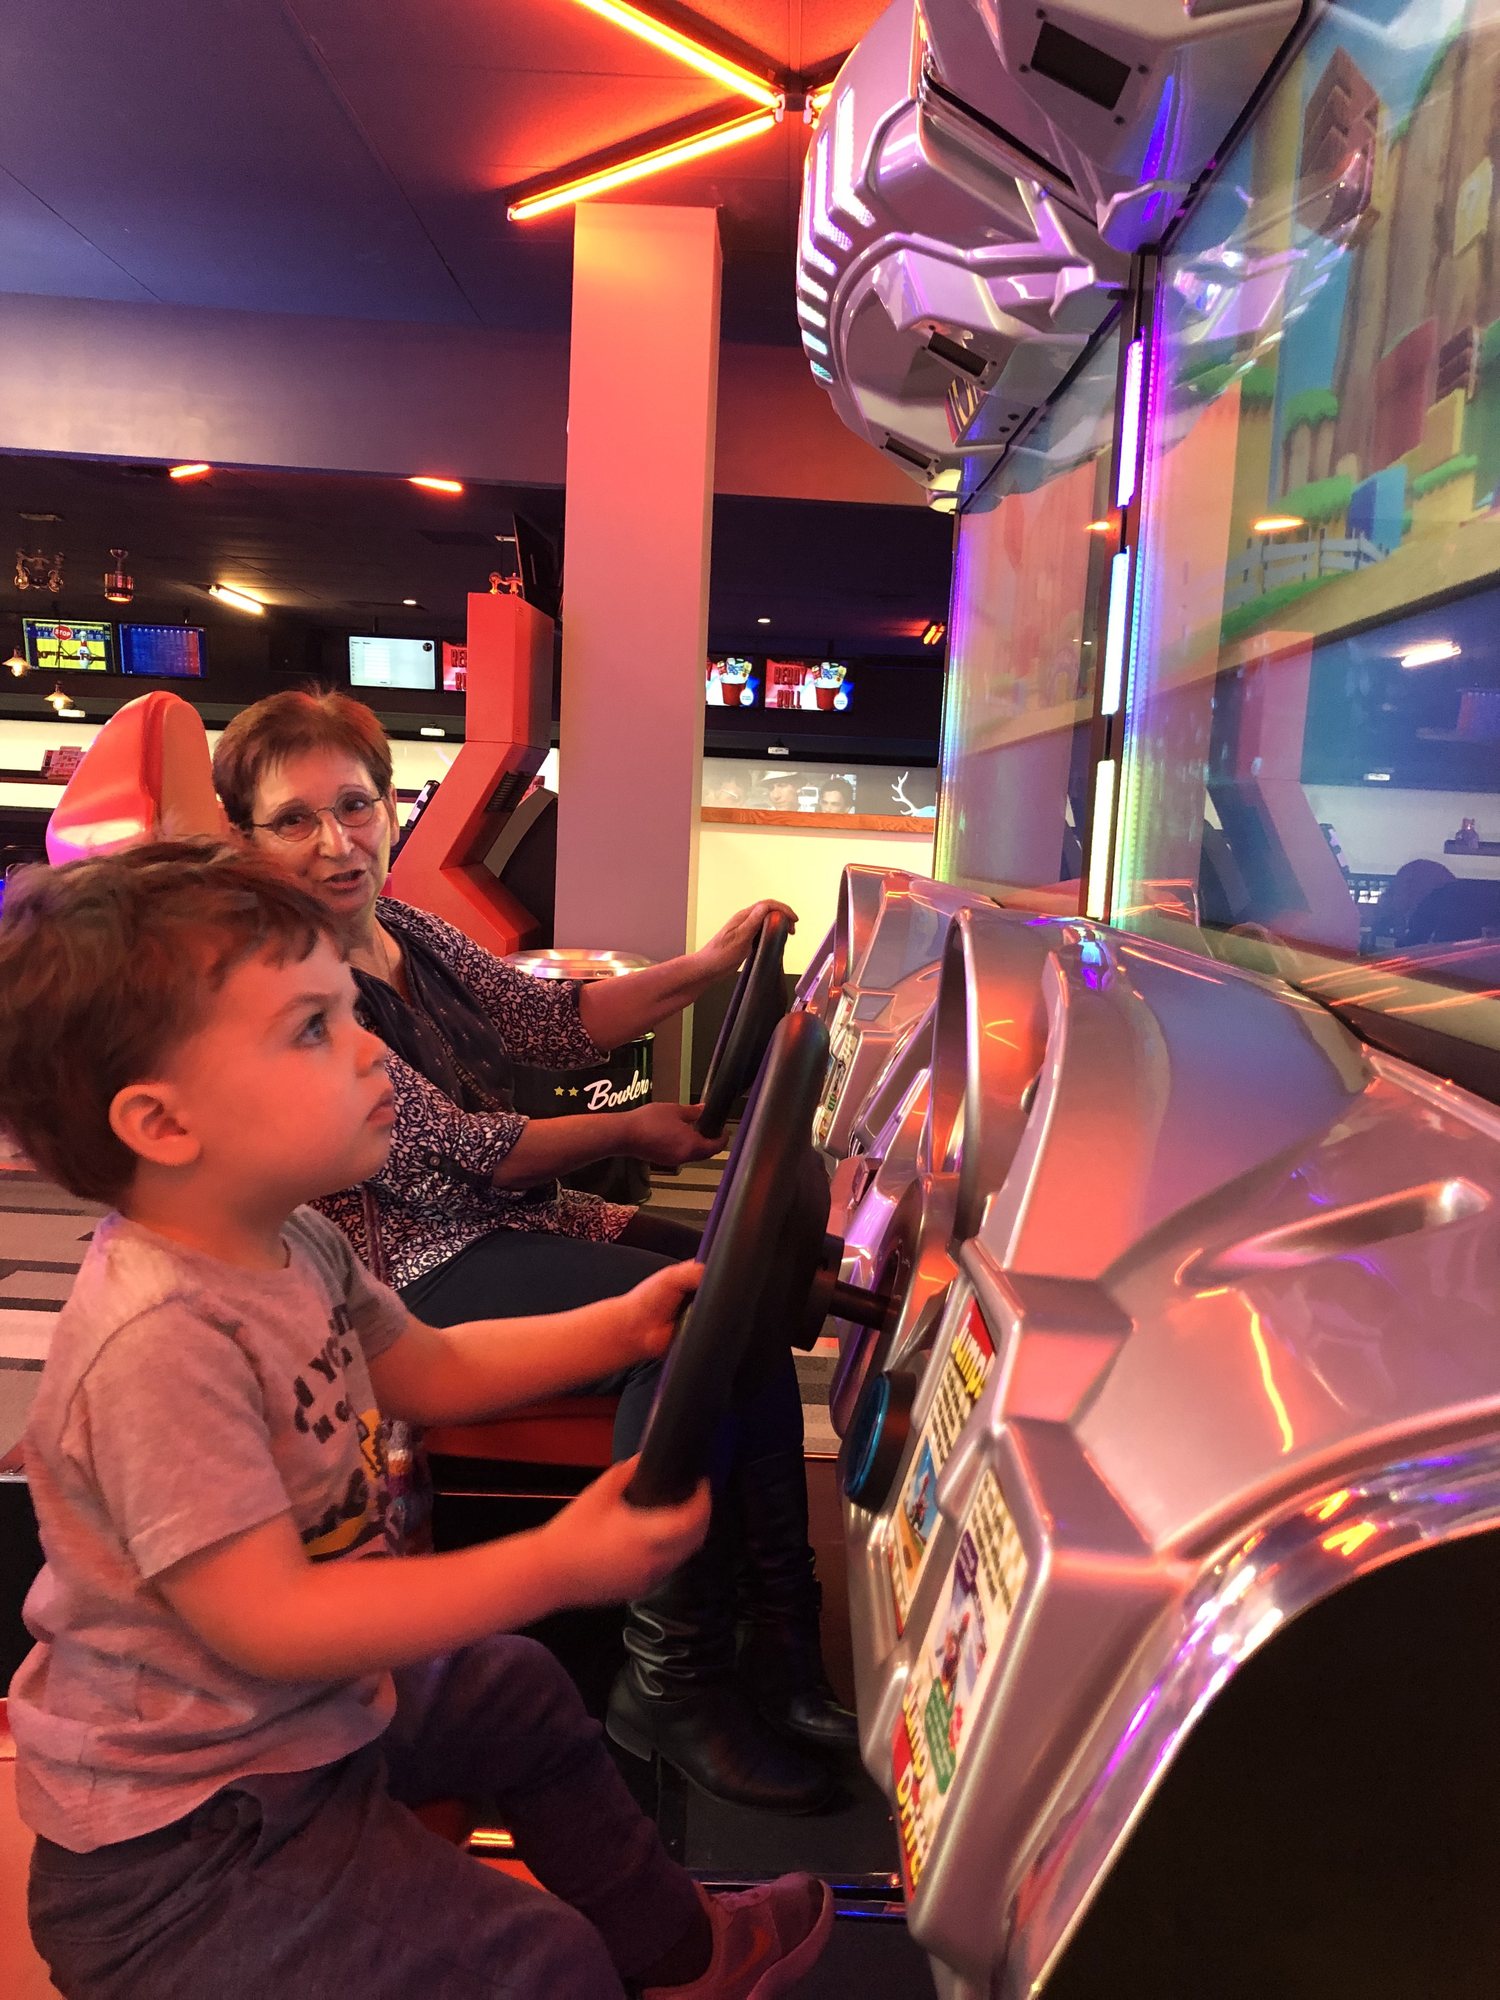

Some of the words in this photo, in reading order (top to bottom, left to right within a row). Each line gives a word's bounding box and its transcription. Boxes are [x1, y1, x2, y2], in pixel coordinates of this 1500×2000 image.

[54, 628, 71, 638] STOP
[774, 666, 808, 686] READY
[777, 689, 802, 709] ROLL
[583, 1069, 650, 1111] Bowlero
